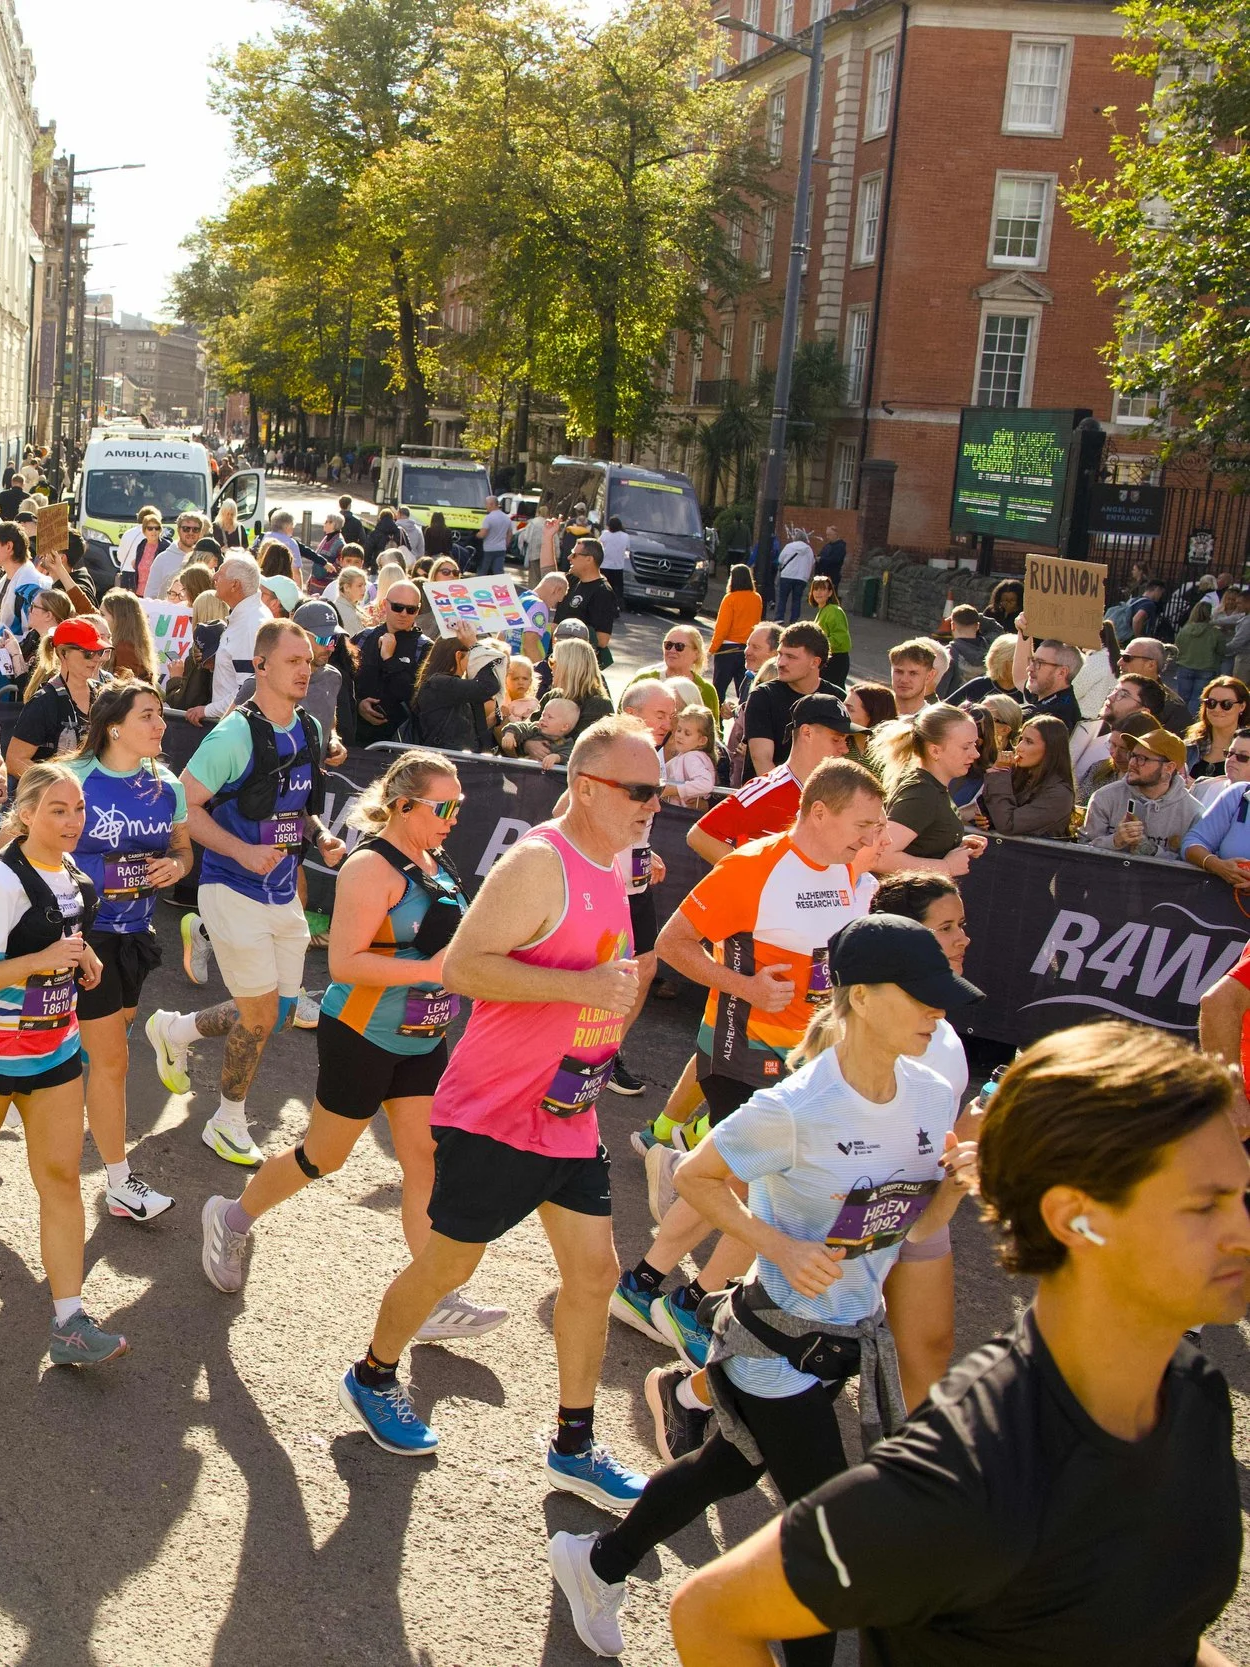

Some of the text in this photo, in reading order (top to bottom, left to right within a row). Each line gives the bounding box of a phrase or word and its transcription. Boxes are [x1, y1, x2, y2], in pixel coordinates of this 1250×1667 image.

[104, 449, 190, 460] AMBULANCE
[1101, 506, 1154, 516] ANGEL HOTEL
[1106, 514, 1147, 523] ENTRANCE
[275, 822, 296, 834] JOSH
[274, 833, 298, 843] 18503
[797, 890, 839, 901] ALZHEIMER'S
[795, 899, 832, 909] RESEARCH
[833, 898, 841, 907] UK
[1029, 909, 1250, 1006] R4W
[43, 1000, 70, 1015] 18610
[427, 1000, 450, 1014] LEAH
[421, 1012, 450, 1026] 25674
[572, 1027, 602, 1048] RUN
[723, 1002, 737, 1061] ALZHEIMER'S
[581, 1073, 605, 1091] NICK
[880, 1183, 922, 1194] CARDIFF HALF
[863, 1199, 911, 1223] HELEN
[861, 1214, 900, 1239] 12092
